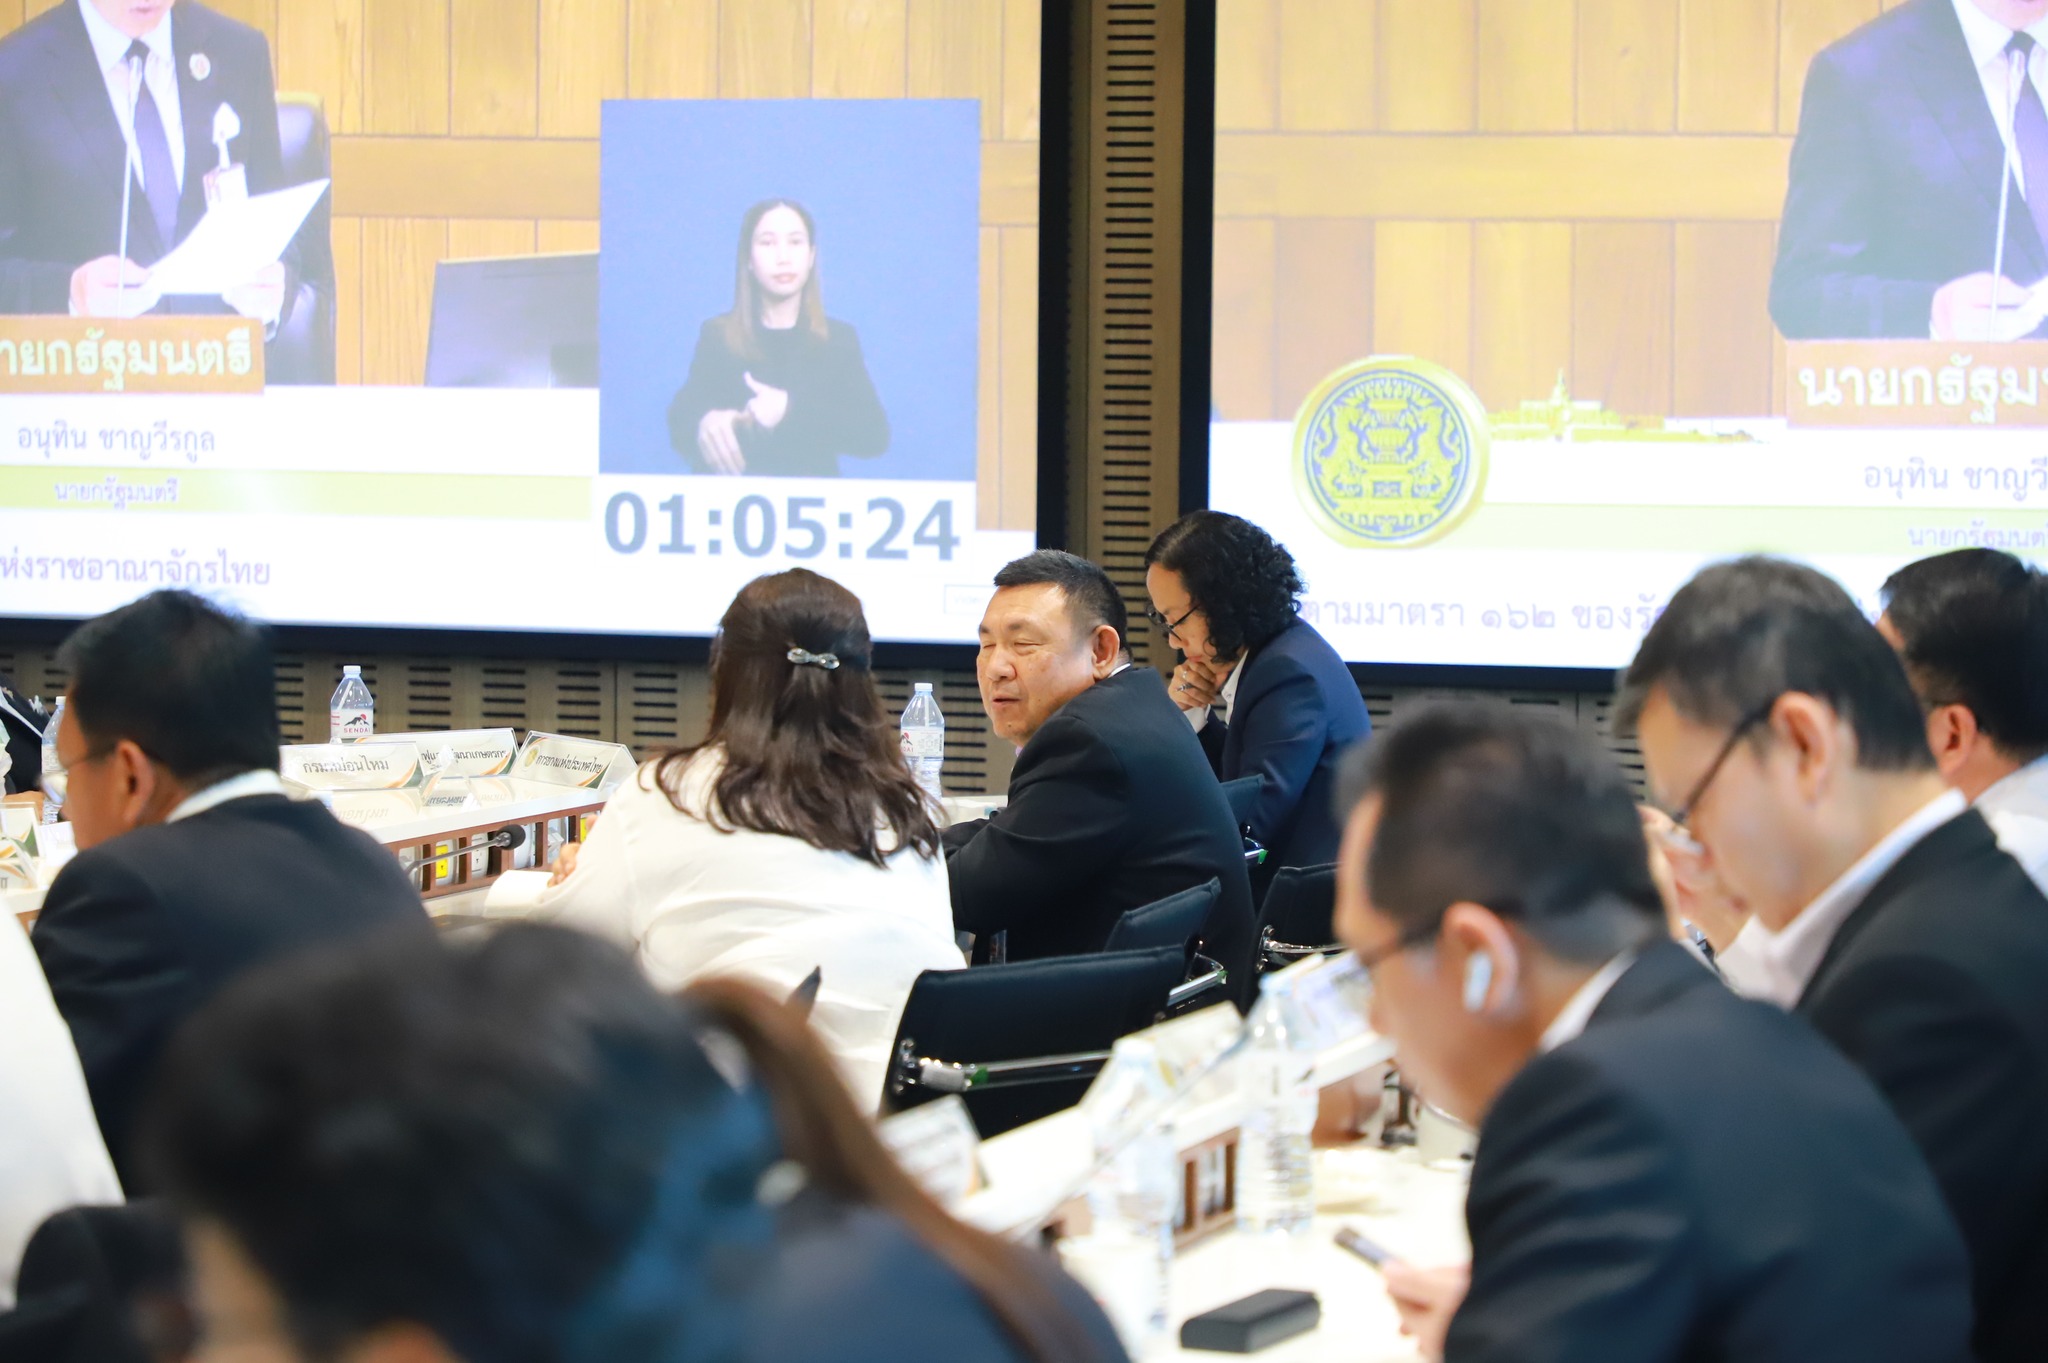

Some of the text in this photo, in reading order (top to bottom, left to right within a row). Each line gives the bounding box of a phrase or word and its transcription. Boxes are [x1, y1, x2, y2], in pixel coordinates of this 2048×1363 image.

[1797, 352, 2048, 424] นายกรัฐม
[18, 419, 215, 463] อนุทิน ชาญวีรกูล
[54, 475, 179, 509] นายกรัฐมนตรี
[1864, 456, 1949, 500] อนุทิน
[604, 491, 961, 561] 01:05:24
[1907, 520, 2048, 550] นายกรัฐมนต
[1481, 603, 1556, 630] ๑๖๒
